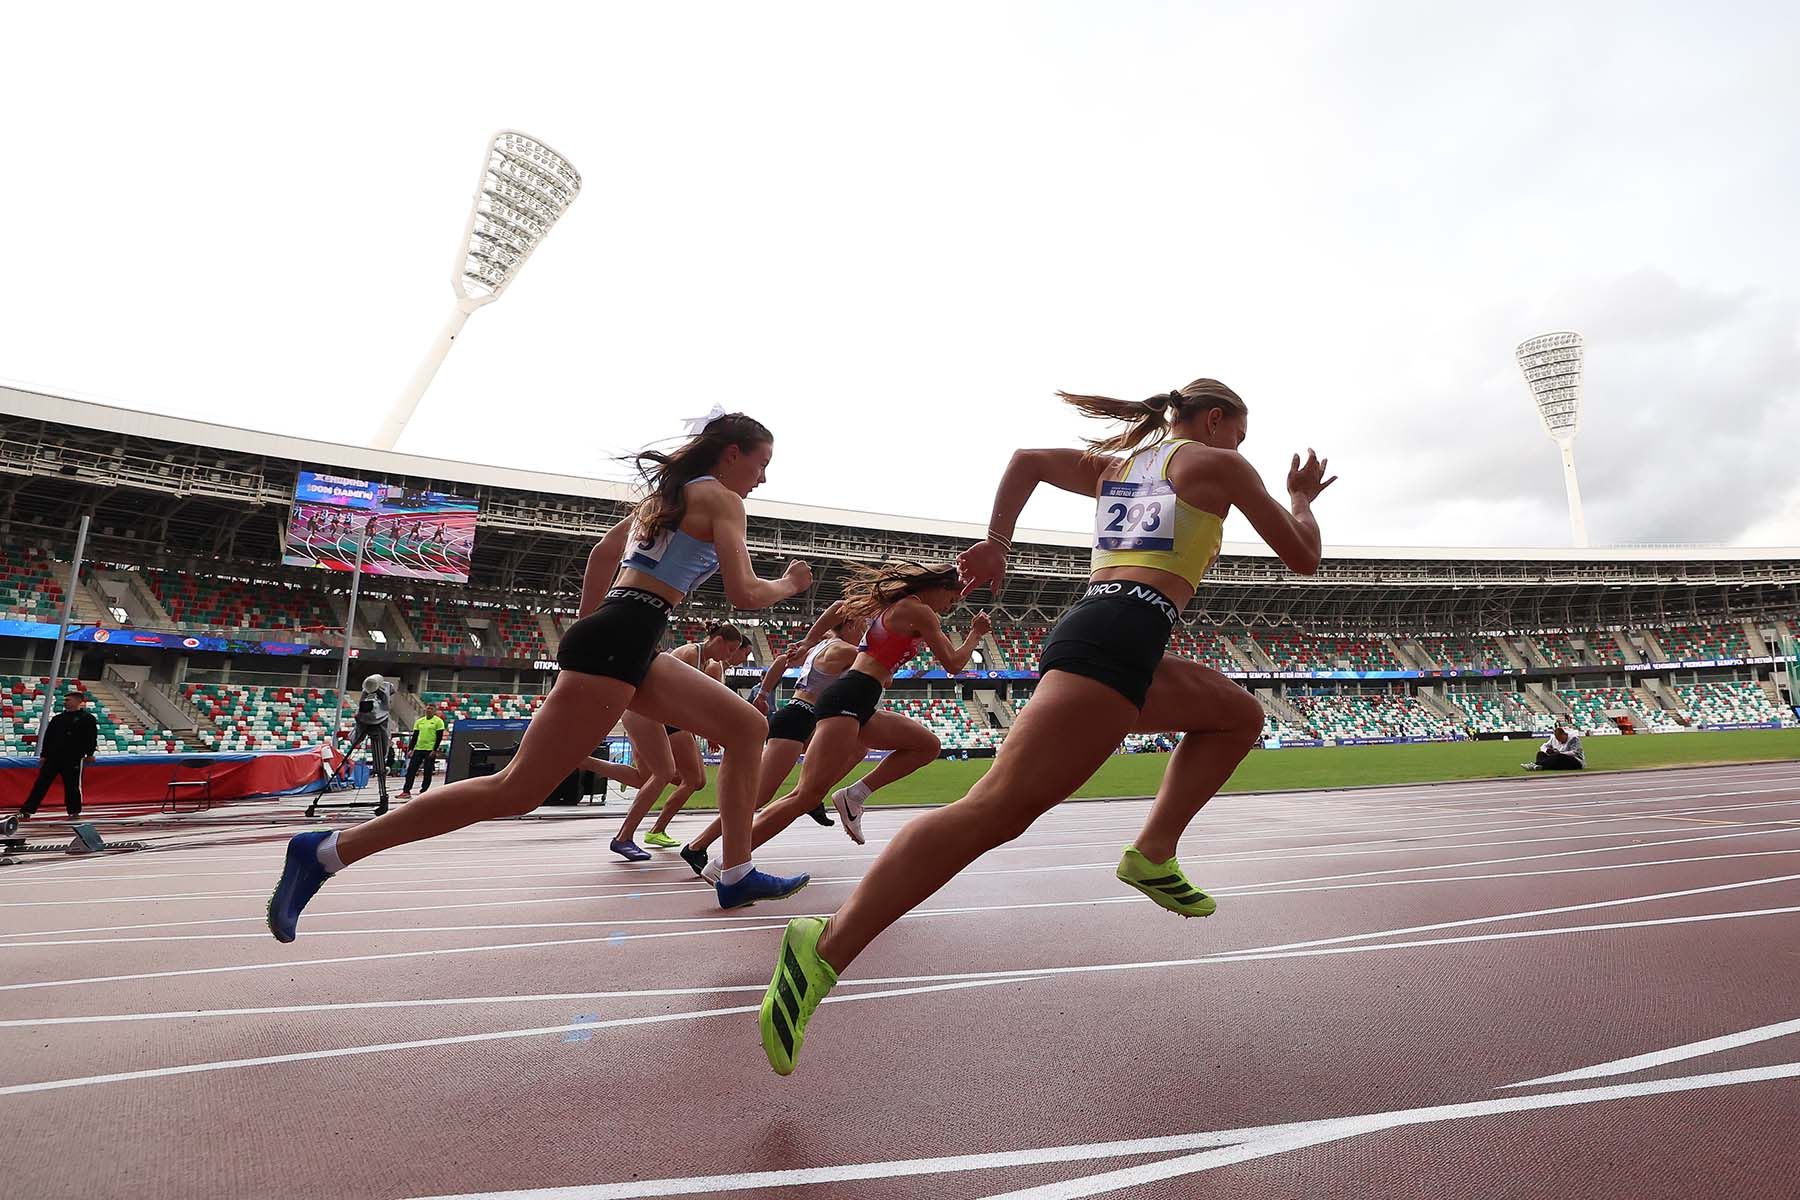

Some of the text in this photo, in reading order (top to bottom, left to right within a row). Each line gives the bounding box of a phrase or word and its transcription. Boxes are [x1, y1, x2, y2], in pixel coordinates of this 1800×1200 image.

[1104, 501, 1161, 532] 293
[1127, 586, 1177, 624] NIKE
[534, 661, 562, 670] ОТКРЫ
